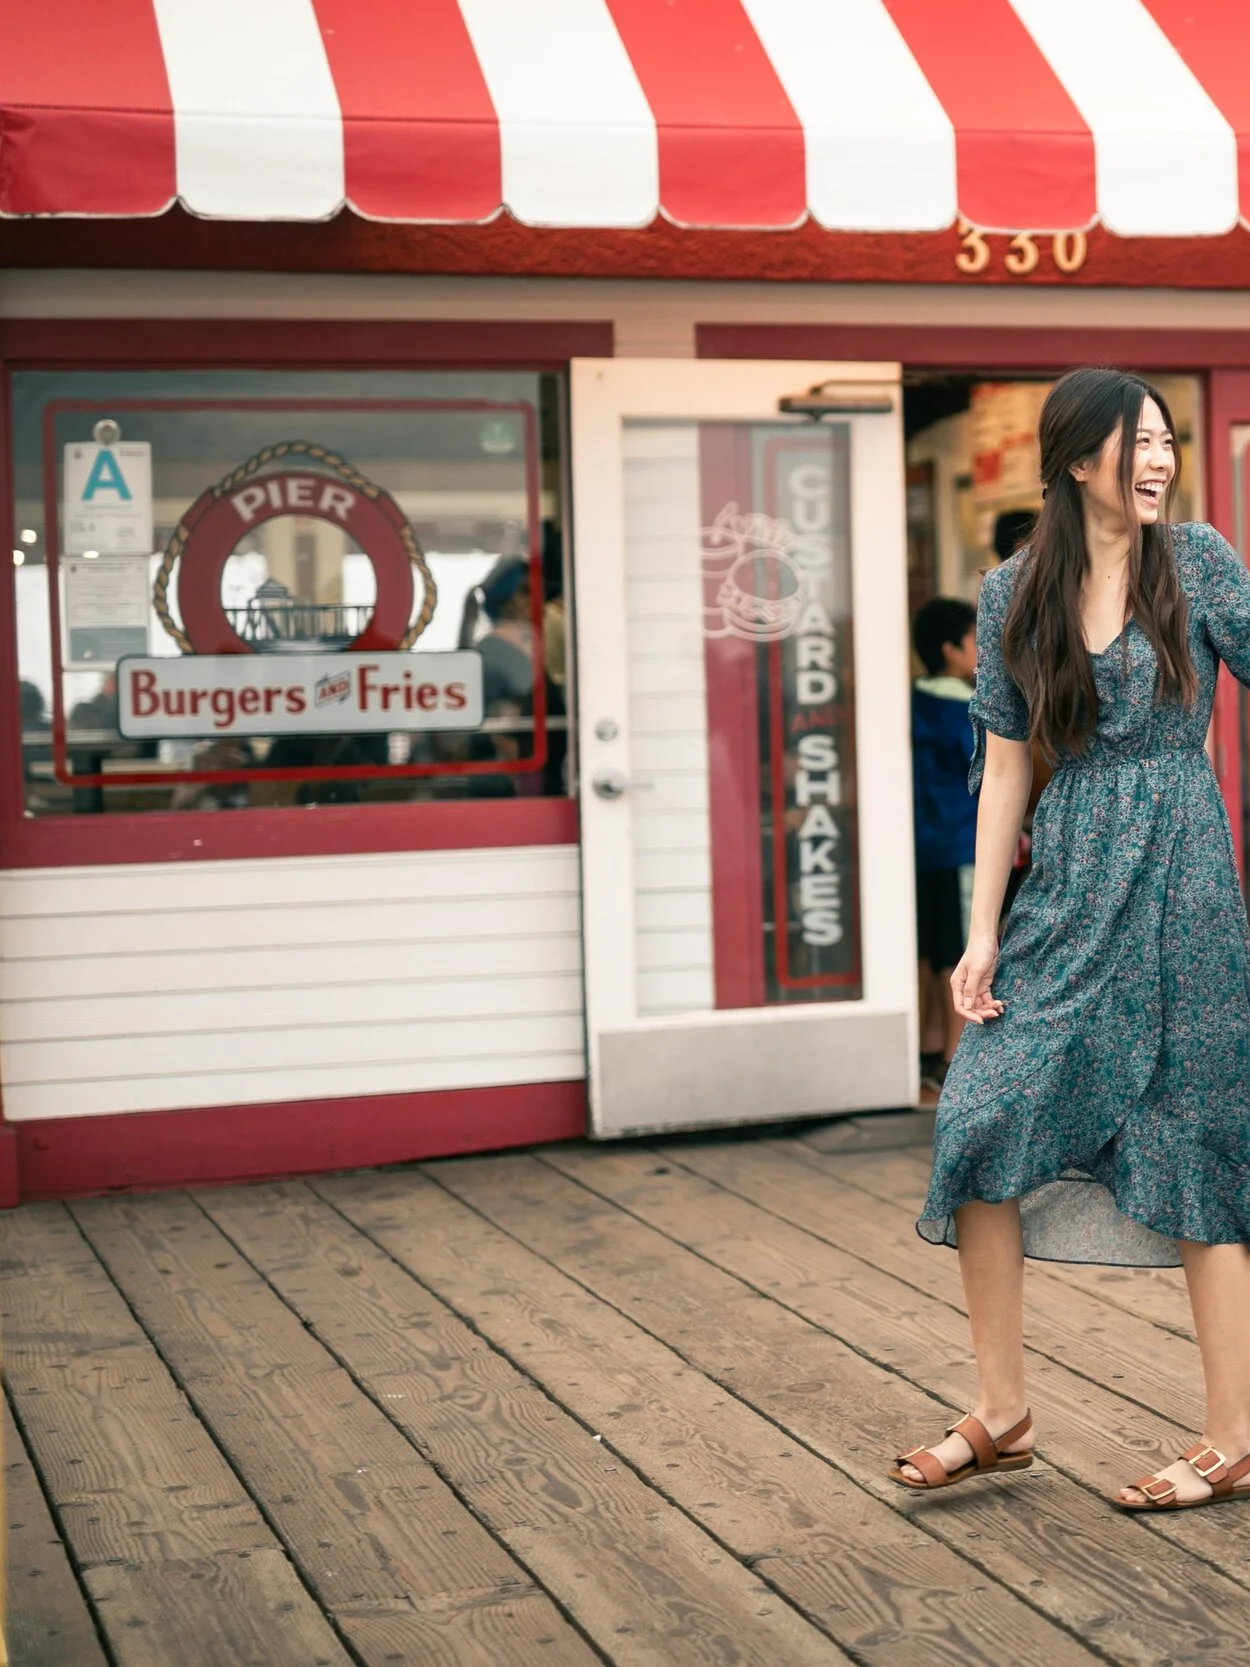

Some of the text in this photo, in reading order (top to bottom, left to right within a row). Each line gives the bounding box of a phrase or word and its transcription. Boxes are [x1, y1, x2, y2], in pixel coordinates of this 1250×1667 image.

[955, 221, 1087, 273] 330
[81, 448, 132, 501] A
[231, 477, 356, 523] PIER
[788, 465, 838, 704] CUSTARD
[129, 664, 468, 729] Burgers AND Fries
[795, 734, 843, 946] SHAKES
